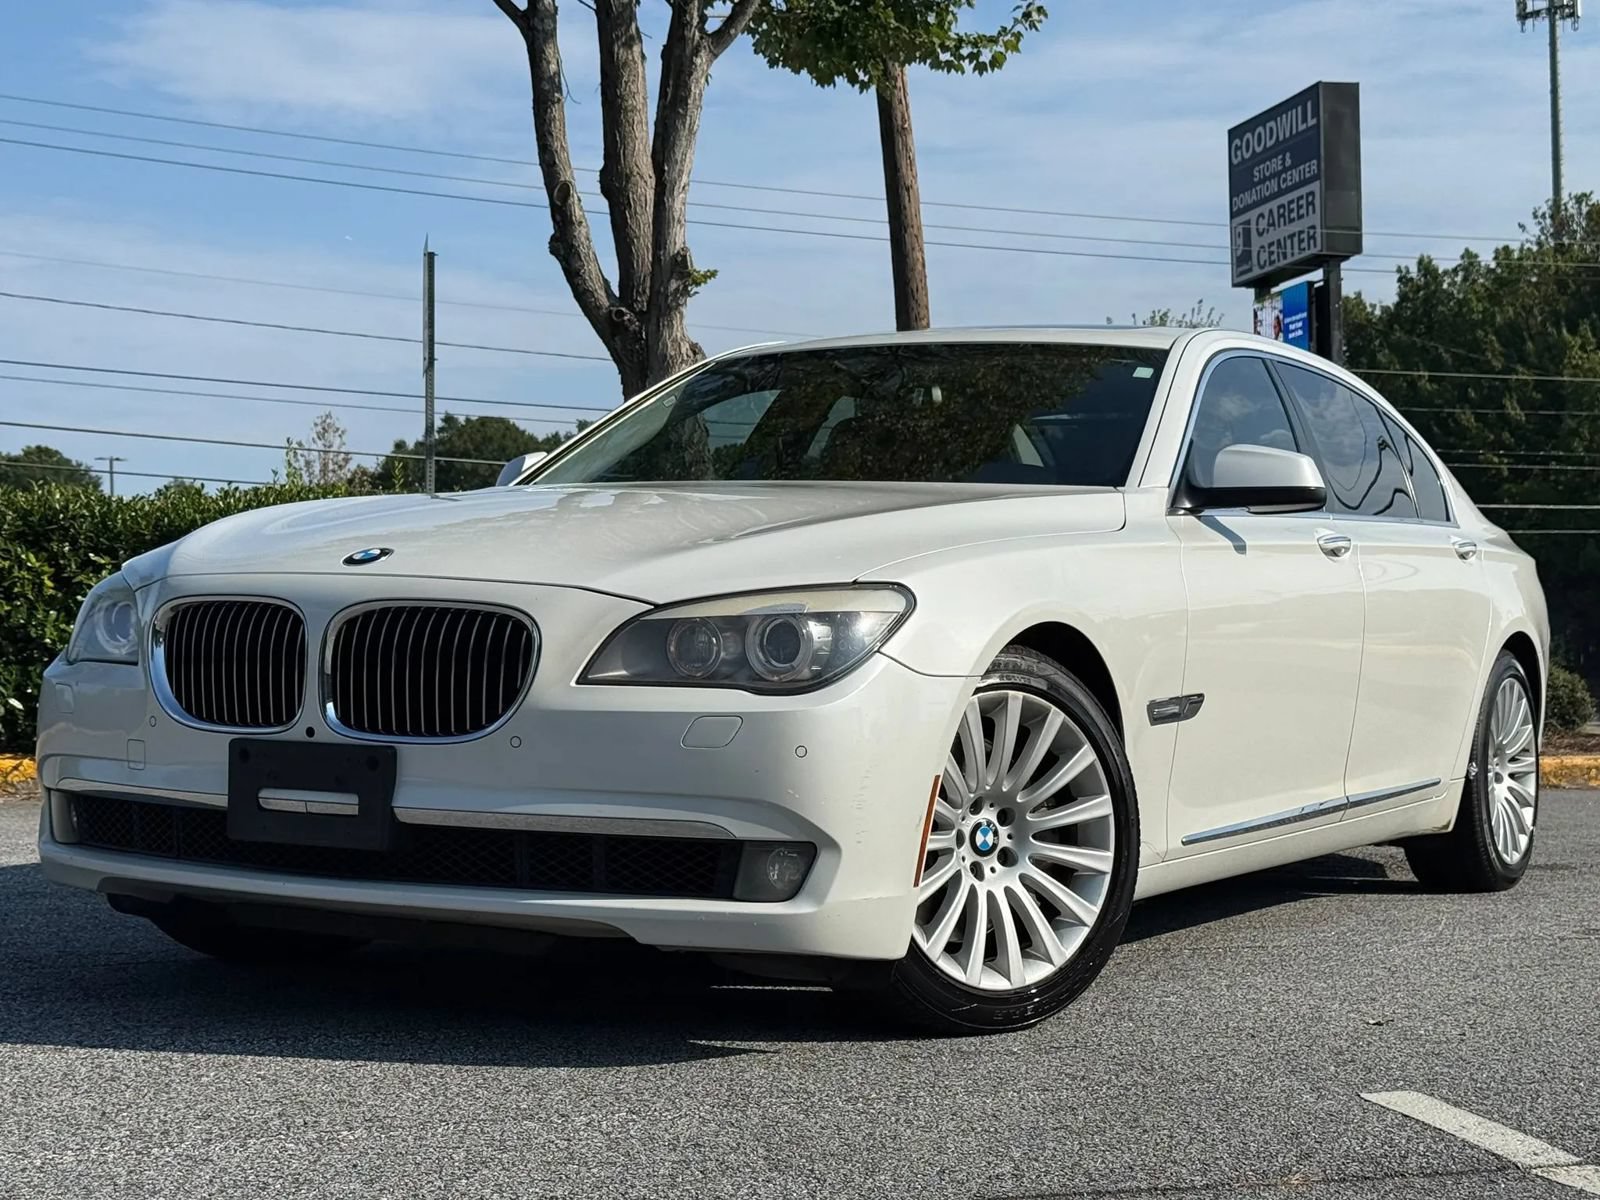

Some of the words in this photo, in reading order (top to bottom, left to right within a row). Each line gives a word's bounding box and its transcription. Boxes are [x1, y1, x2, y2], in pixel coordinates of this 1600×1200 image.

[1231, 100, 1317, 165] GOODWILL
[1232, 177, 1278, 211] DONATION
[1280, 160, 1318, 189] CENTER
[1253, 155, 1283, 182] STORE
[1285, 152, 1292, 167] &
[1255, 190, 1316, 237] CAREER
[1256, 225, 1317, 270] CENTER
